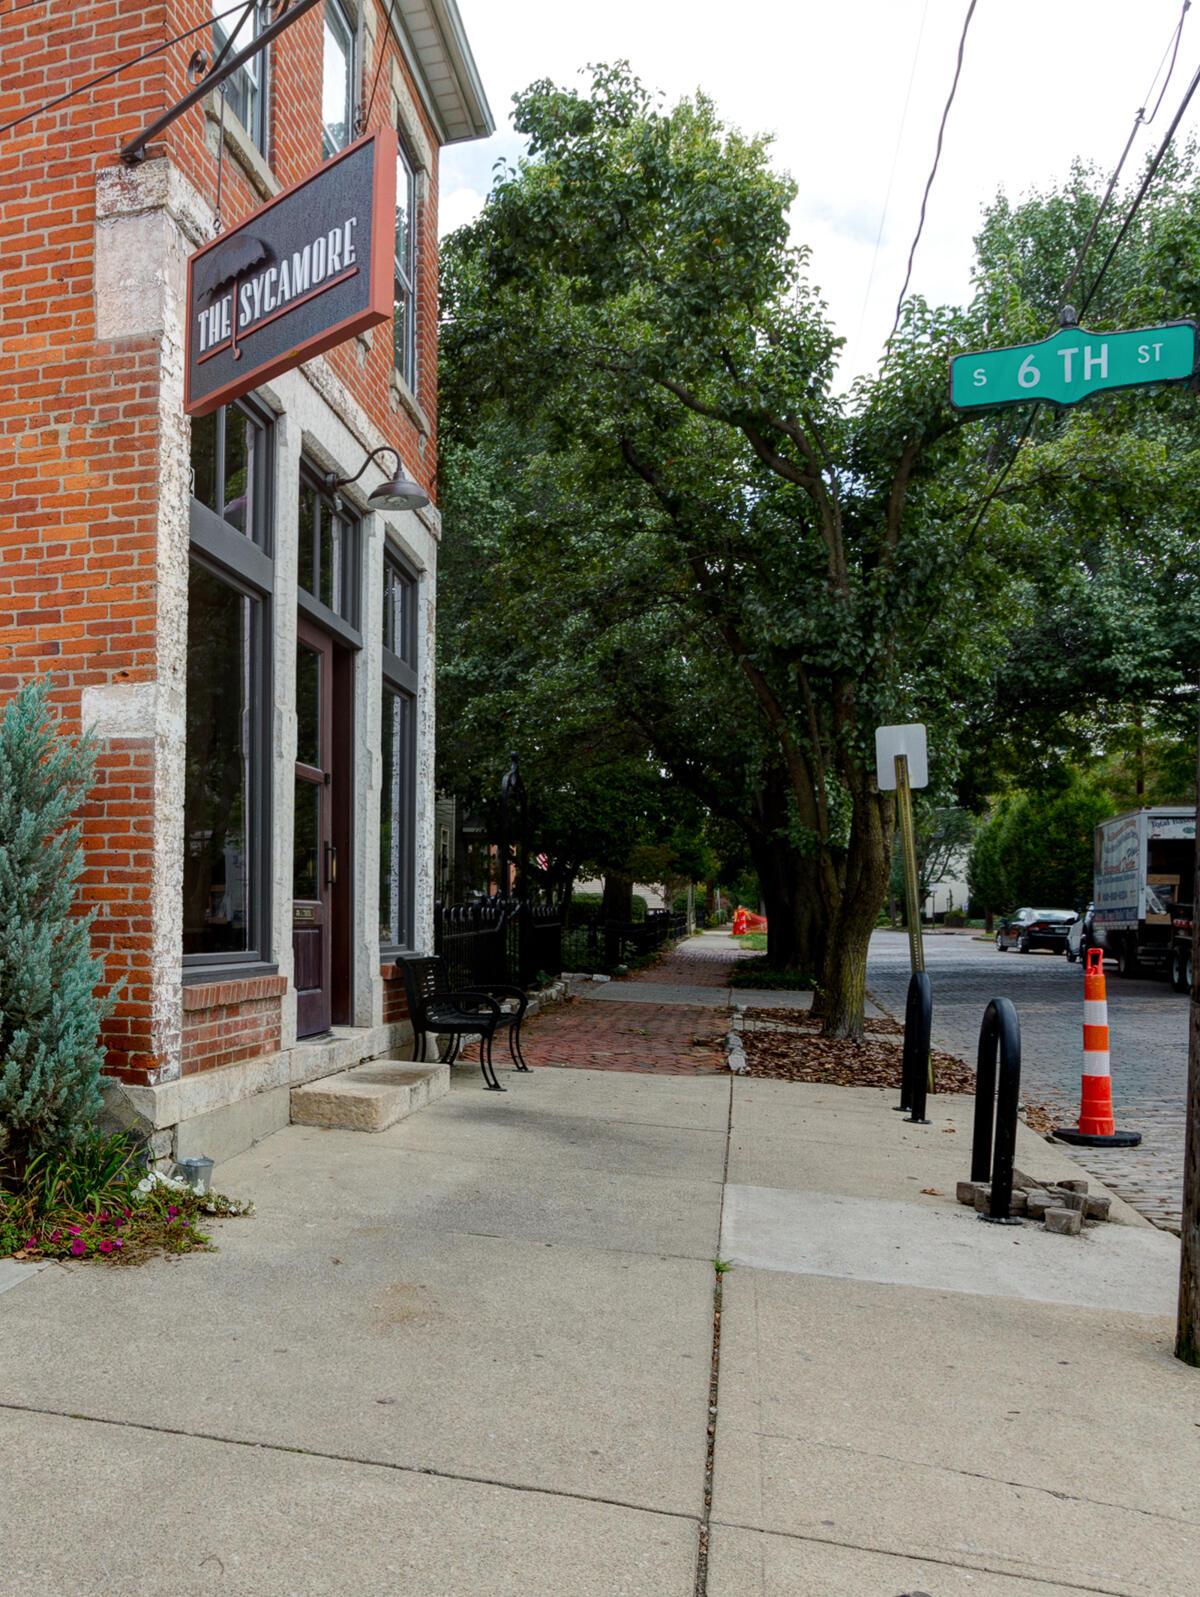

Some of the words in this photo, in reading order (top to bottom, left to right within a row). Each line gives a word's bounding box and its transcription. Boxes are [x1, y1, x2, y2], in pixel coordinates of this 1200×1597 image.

[197, 294, 232, 352] THE
[239, 216, 358, 327] SYCAMORE
[972, 368, 988, 387] S
[1137, 342, 1164, 364] ST
